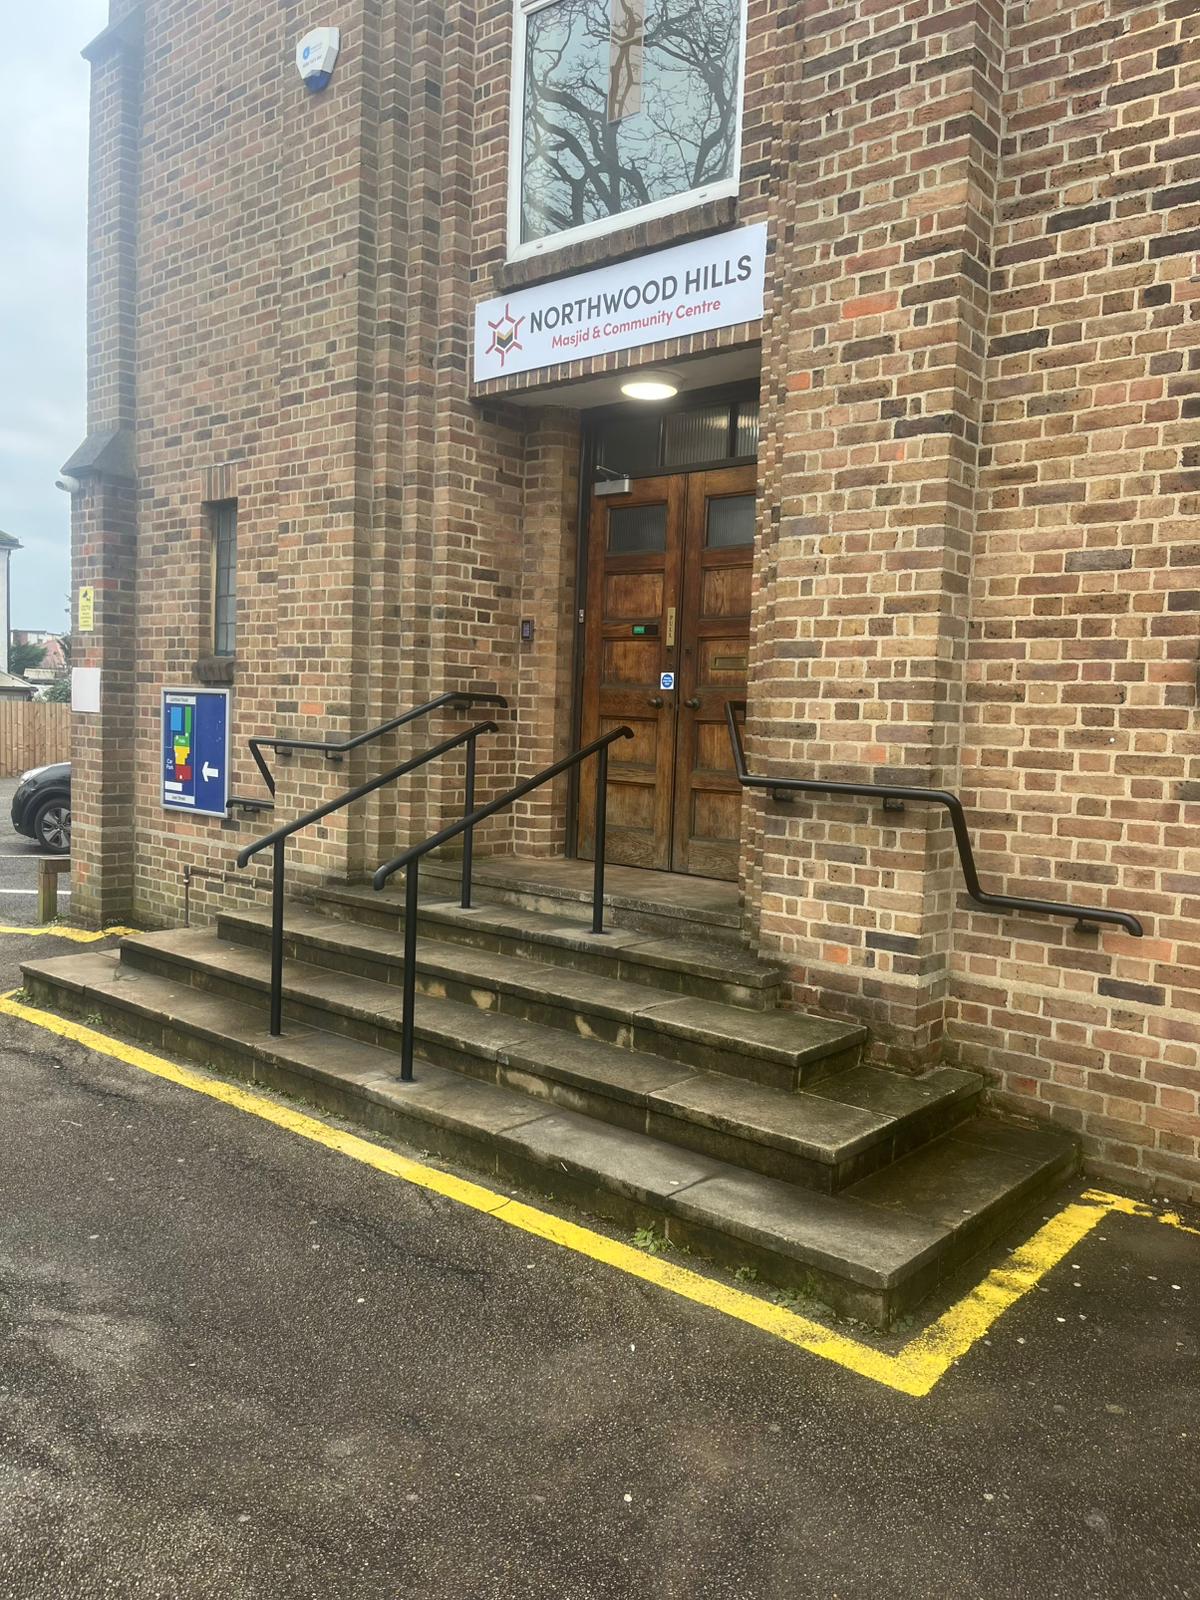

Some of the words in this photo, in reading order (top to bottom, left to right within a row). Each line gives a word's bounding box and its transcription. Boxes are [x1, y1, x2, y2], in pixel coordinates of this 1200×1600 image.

[530, 275, 678, 333] NORTHWOOD
[685, 255, 752, 295] HILLS
[551, 328, 590, 349] Masjid
[592, 326, 601, 339] &
[603, 310, 674, 337] Community
[675, 299, 721, 320] Centre
